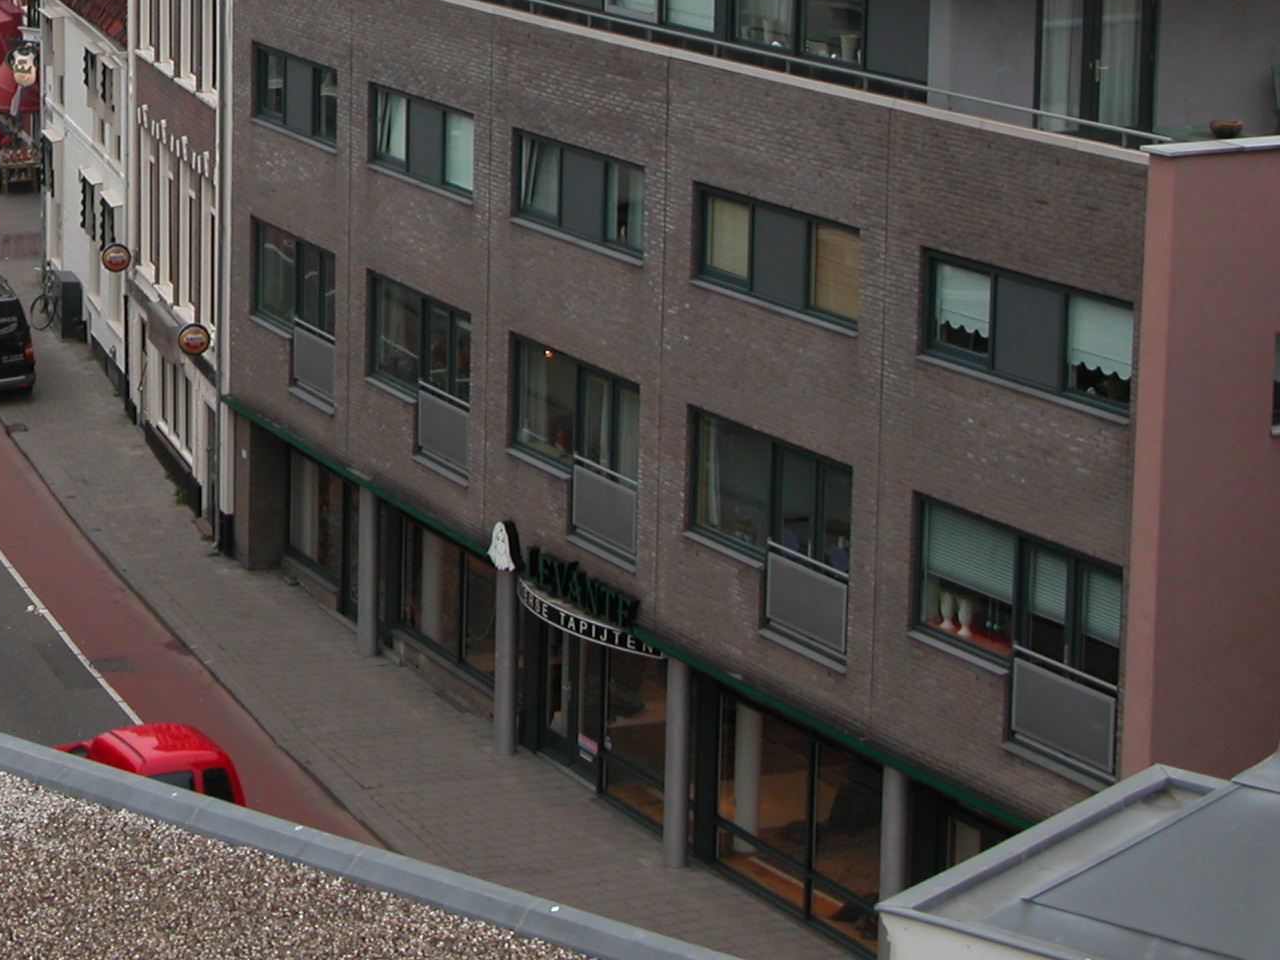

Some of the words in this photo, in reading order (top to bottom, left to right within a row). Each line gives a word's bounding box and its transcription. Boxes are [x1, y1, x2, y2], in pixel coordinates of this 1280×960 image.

[520, 584, 548, 618] ERSE
[559, 612, 654, 654] TAPIJTEN
[526, 547, 635, 628] LEVANTE
